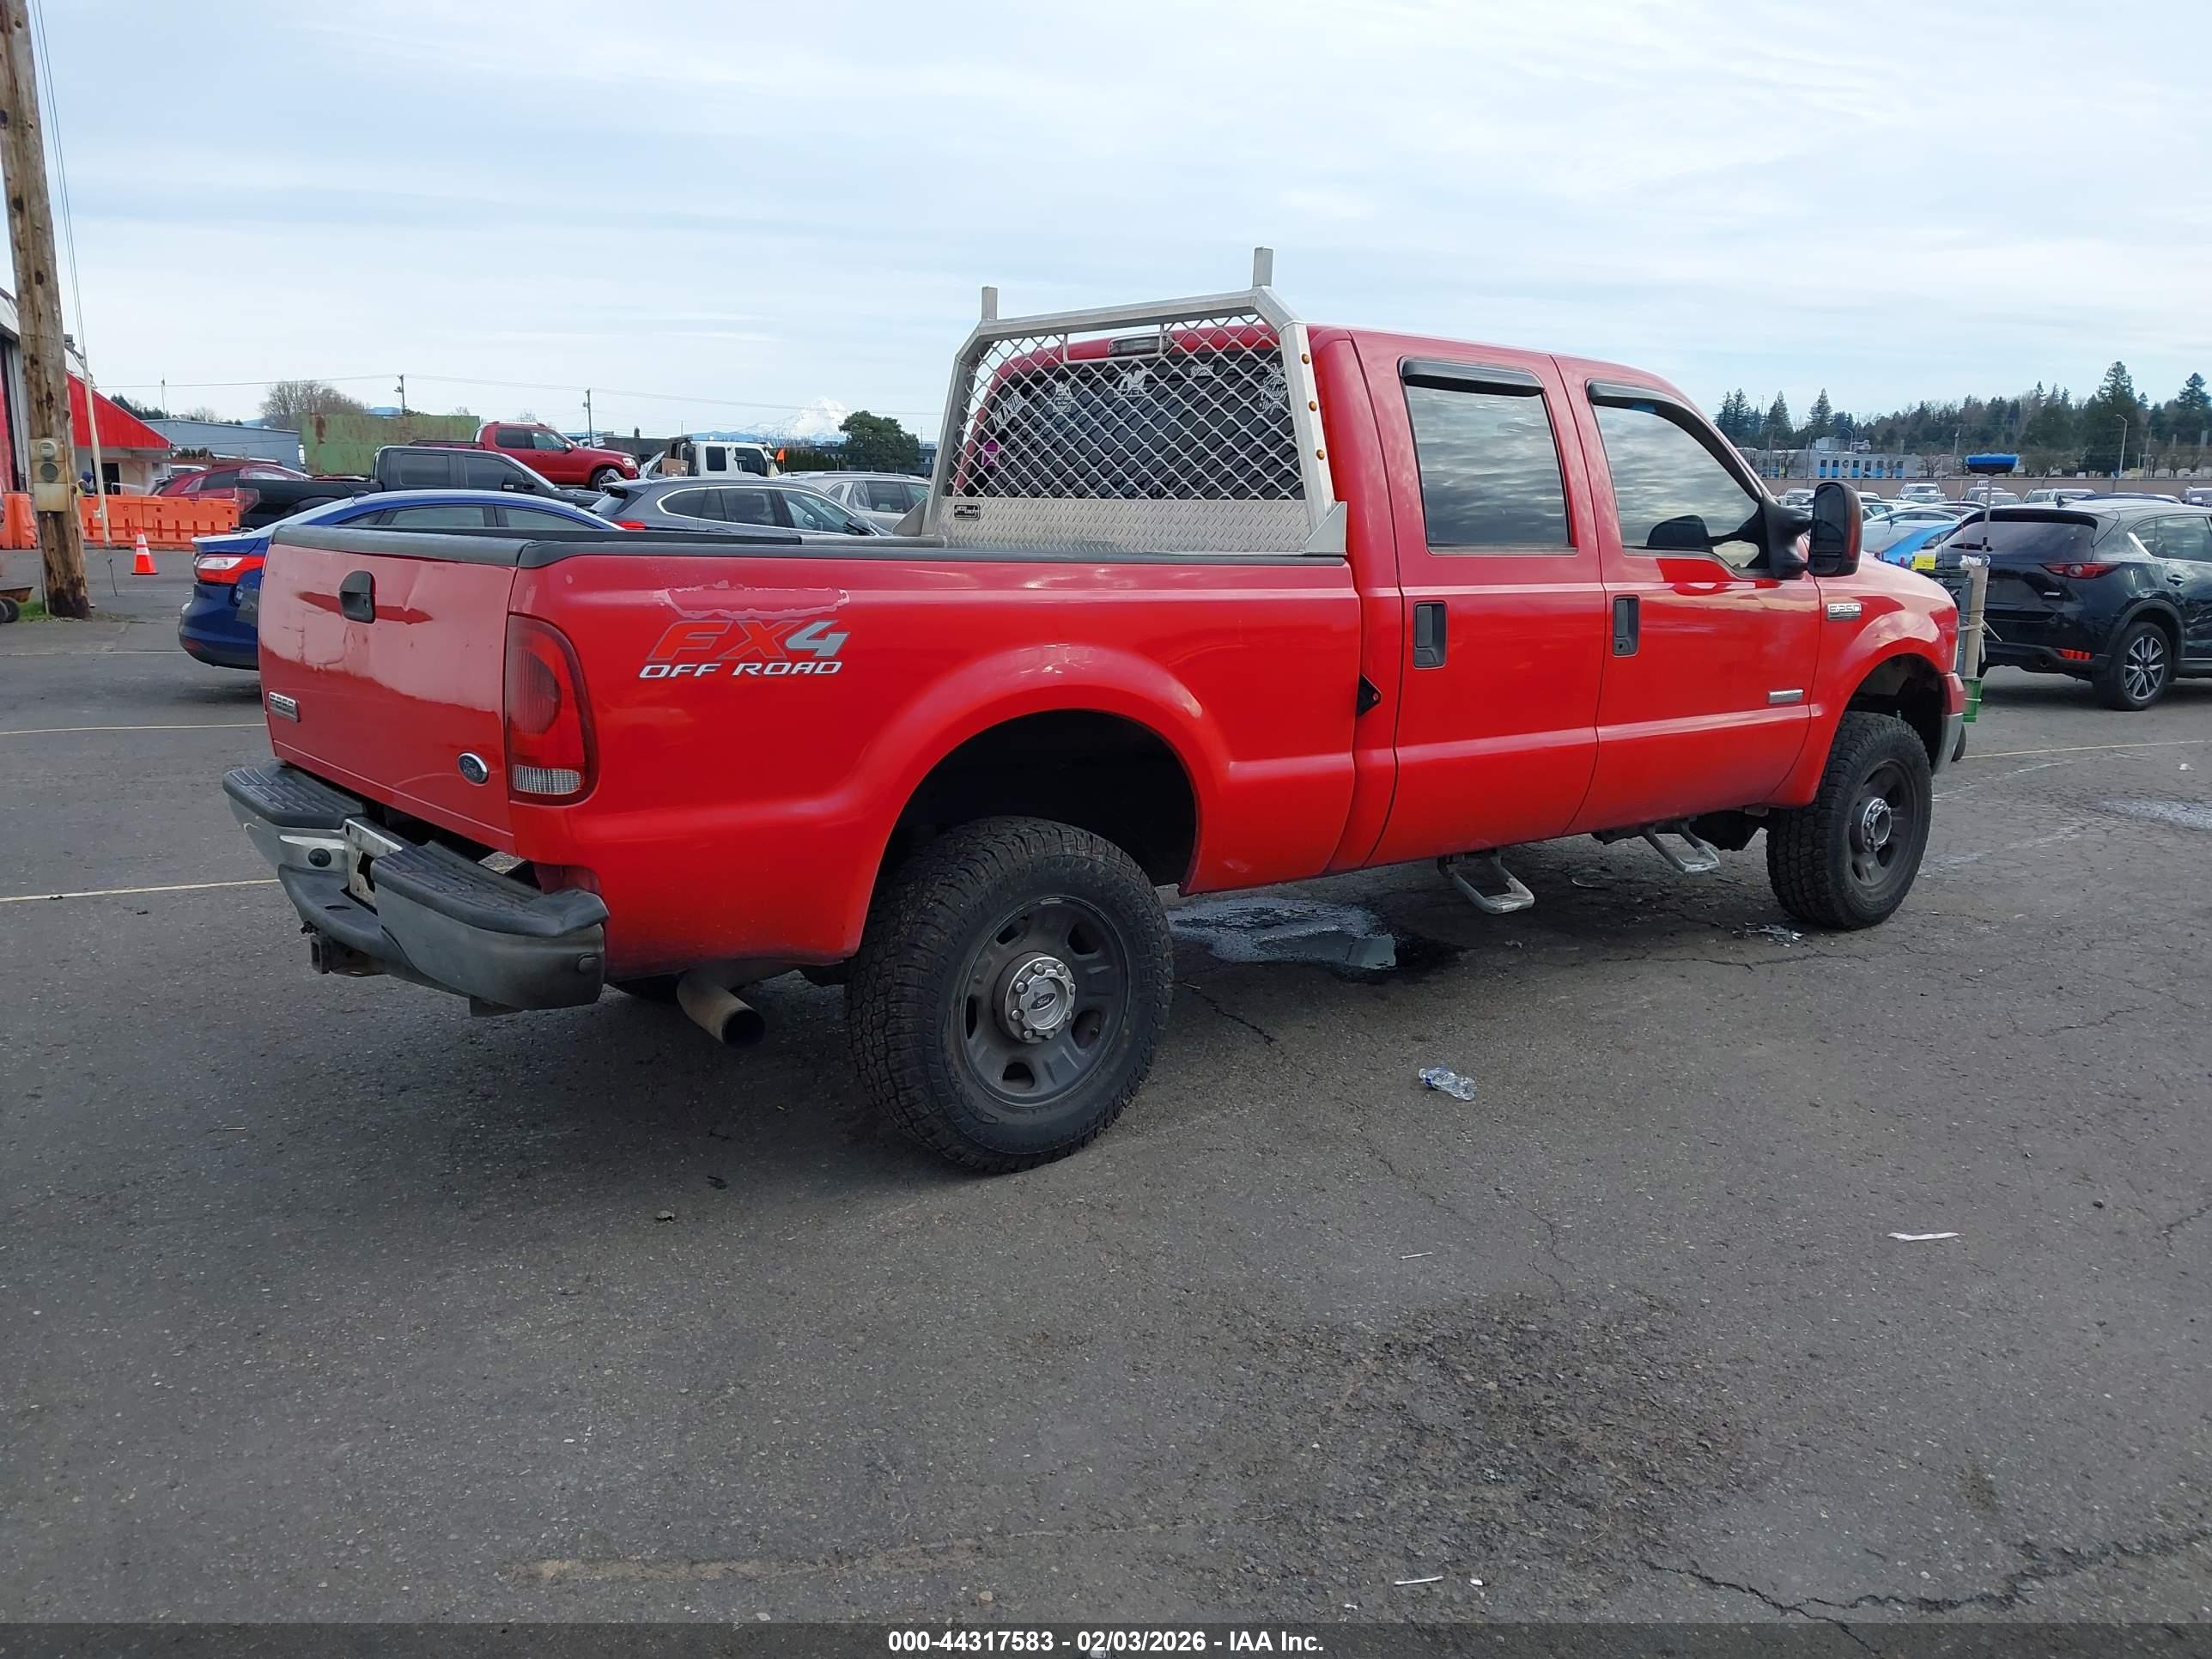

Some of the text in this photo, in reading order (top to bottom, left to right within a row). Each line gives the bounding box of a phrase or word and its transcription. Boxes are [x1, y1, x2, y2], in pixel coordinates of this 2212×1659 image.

[647, 619, 850, 660] FX4
[639, 661, 842, 678] OFF ROAD
